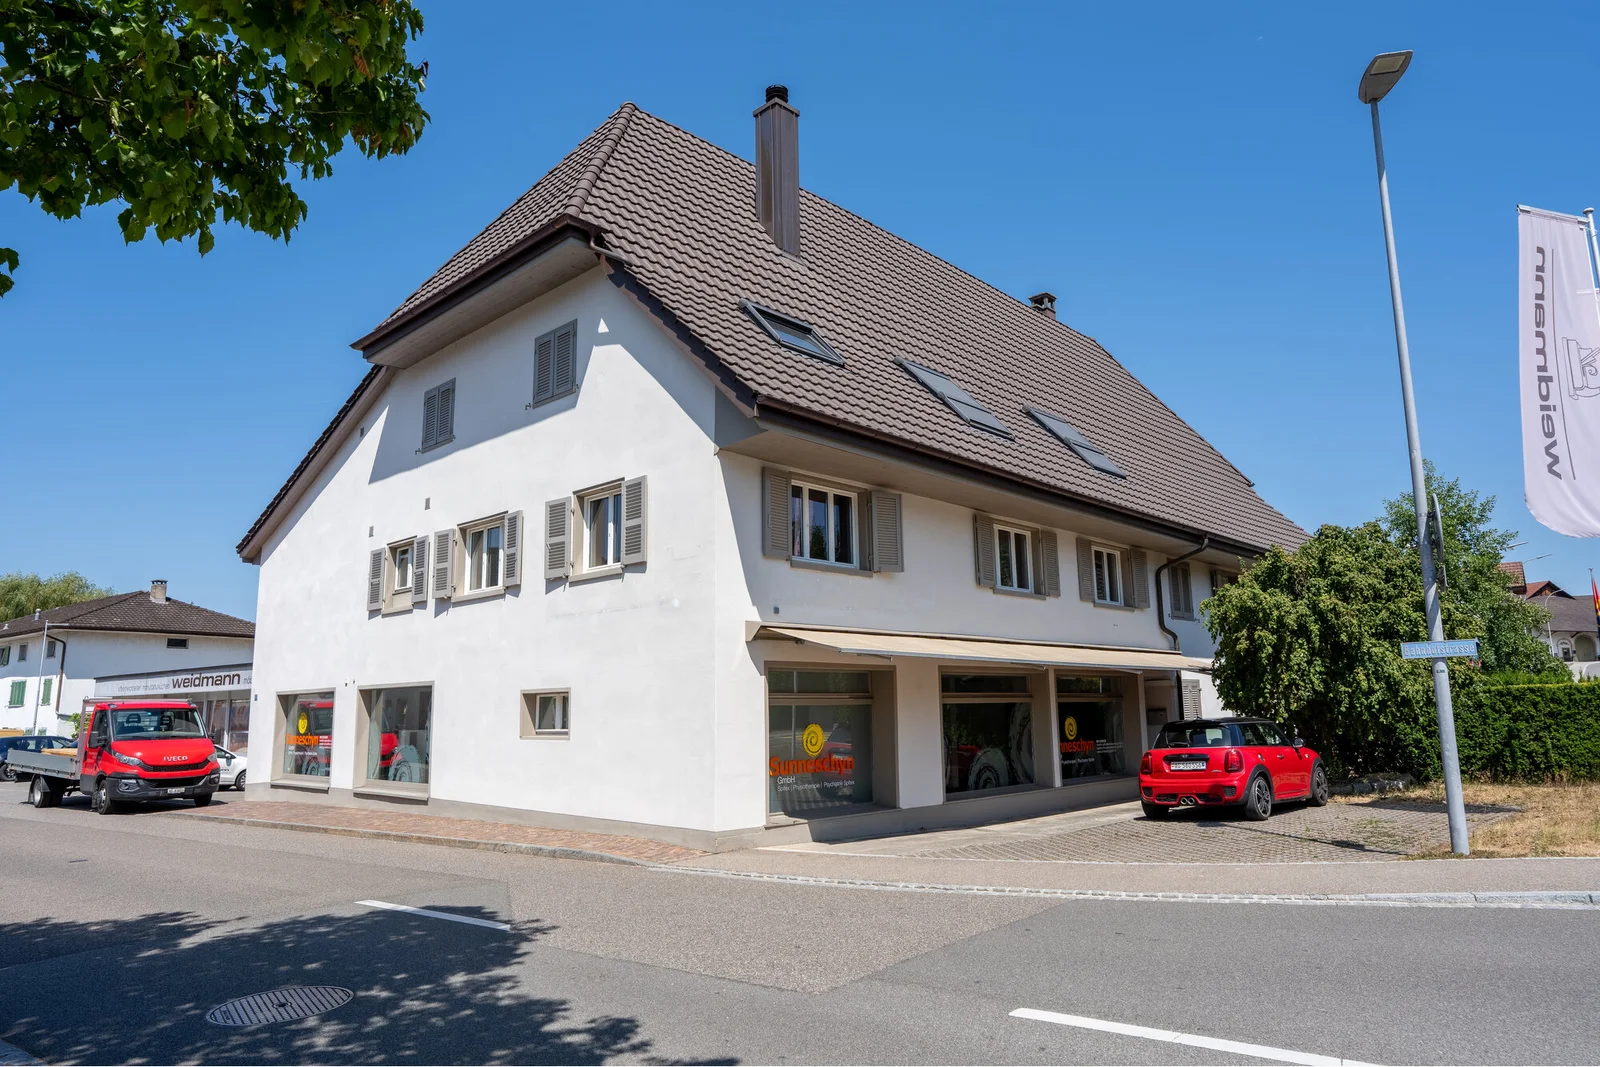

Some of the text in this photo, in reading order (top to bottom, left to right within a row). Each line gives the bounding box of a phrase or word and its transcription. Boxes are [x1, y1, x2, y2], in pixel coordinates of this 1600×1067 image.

[1404, 643, 1475, 656] Bahnhofstrasse
[172, 673, 241, 689] weidmann
[769, 753, 855, 777] Sunneschyn
[777, 776, 796, 785] GmbH
